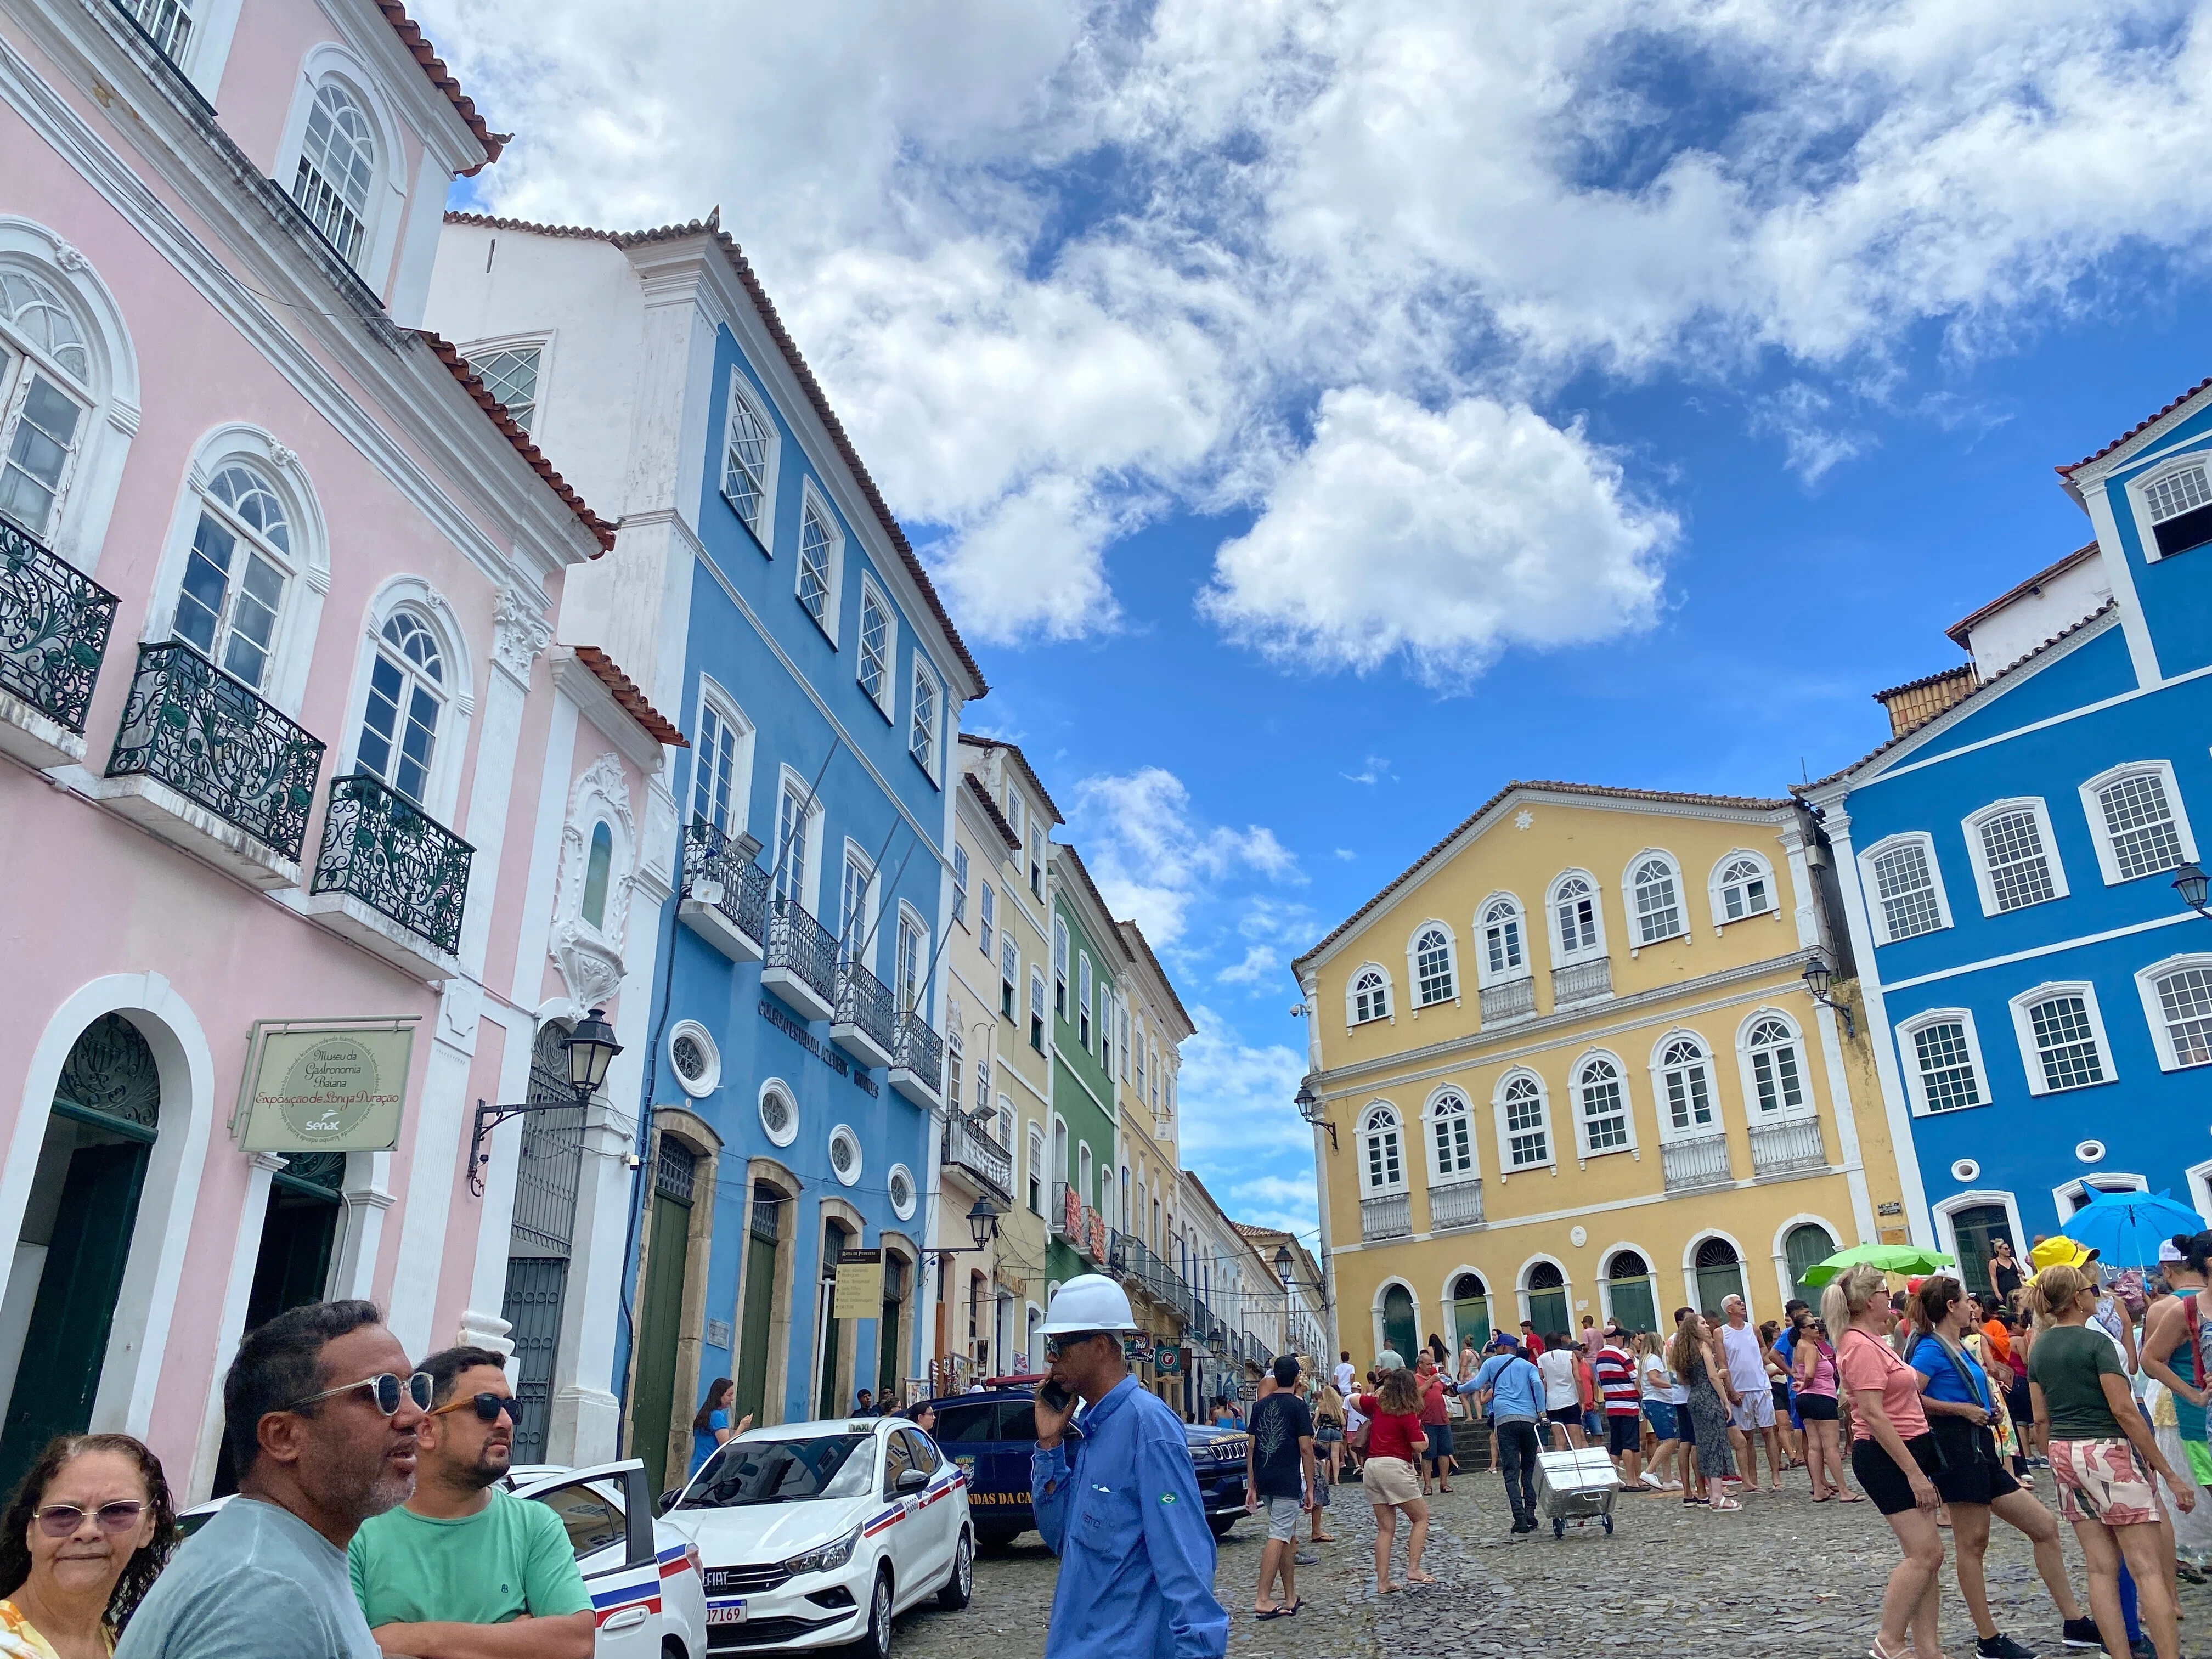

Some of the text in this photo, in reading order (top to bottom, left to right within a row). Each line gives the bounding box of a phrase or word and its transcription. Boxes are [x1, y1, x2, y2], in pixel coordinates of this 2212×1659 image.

[313, 1049, 357, 1062] Museu da
[304, 1062, 361, 1080] Gastronomia
[313, 1075, 347, 1088] Baiana
[256, 1090, 399, 1111] Exposição de Longa Duração
[968, 1492, 1032, 1505] NDAS DA CA
[707, 1571, 729, 1586] FIAT
[706, 1607, 740, 1622] J7I69
